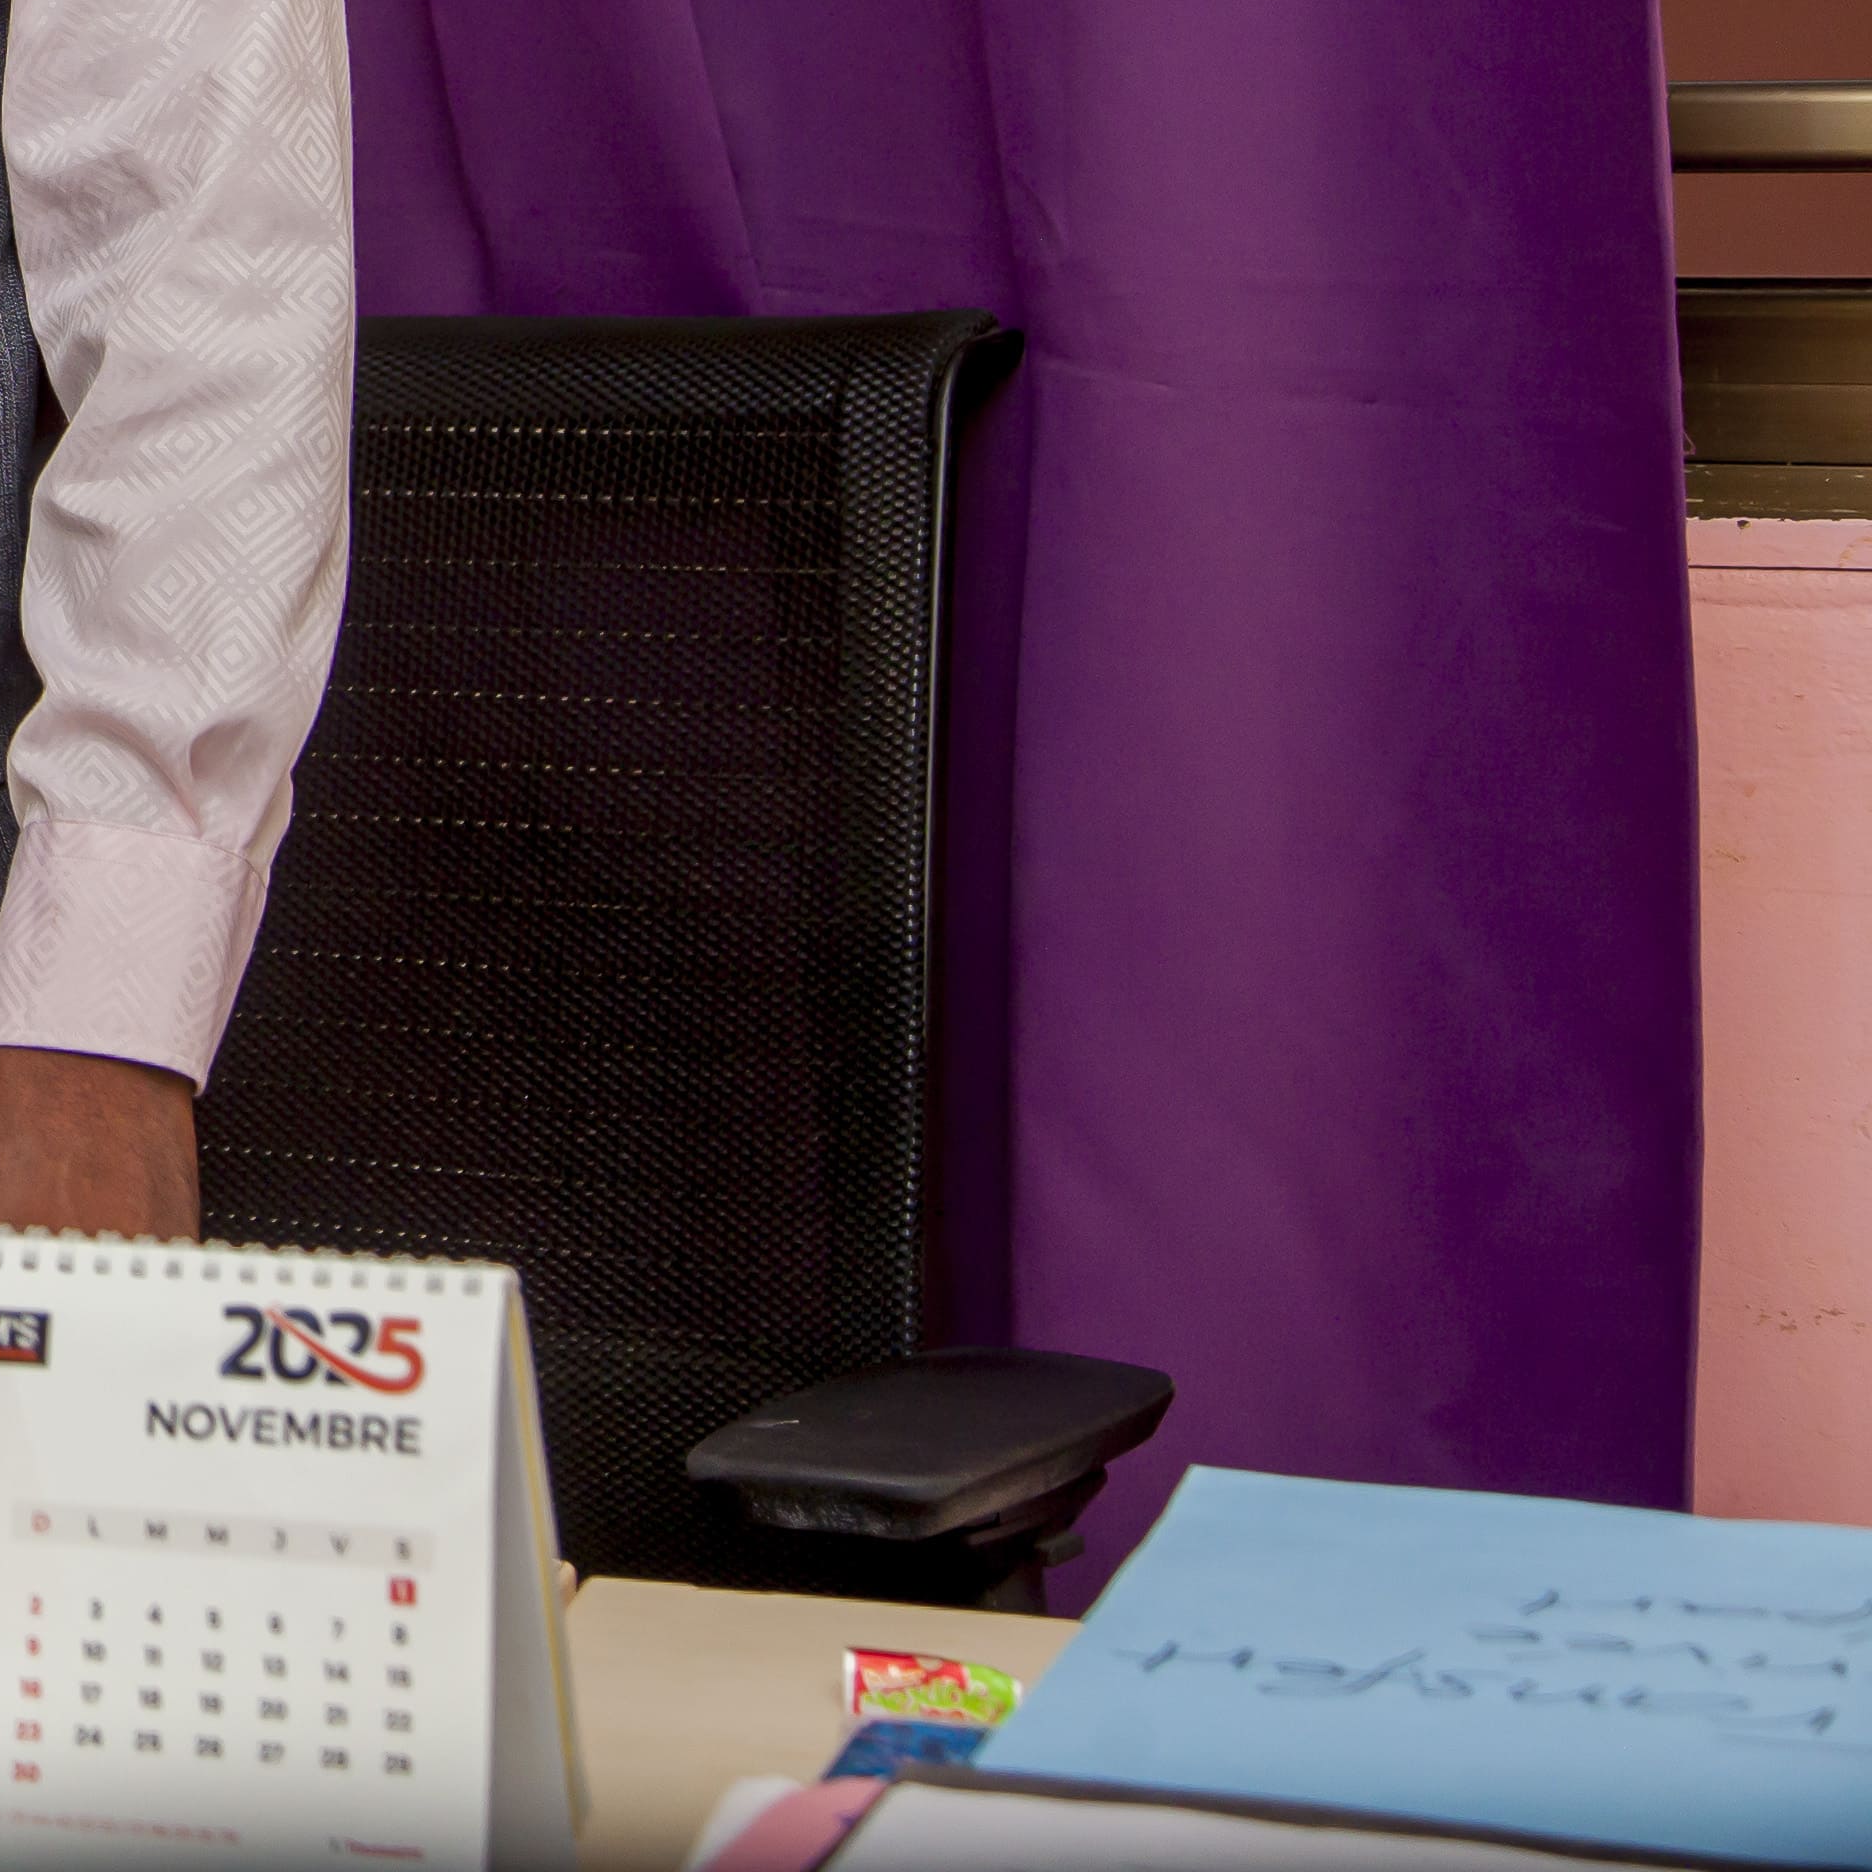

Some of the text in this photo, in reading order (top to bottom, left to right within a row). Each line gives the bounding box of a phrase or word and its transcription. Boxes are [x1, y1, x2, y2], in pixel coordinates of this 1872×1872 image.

[219, 1303, 425, 1396] 2025
[145, 1400, 423, 1456] NOVEMBRE
[146, 1521, 168, 1541] M
[206, 1526, 229, 1545] M
[330, 1535, 350, 1556] V
